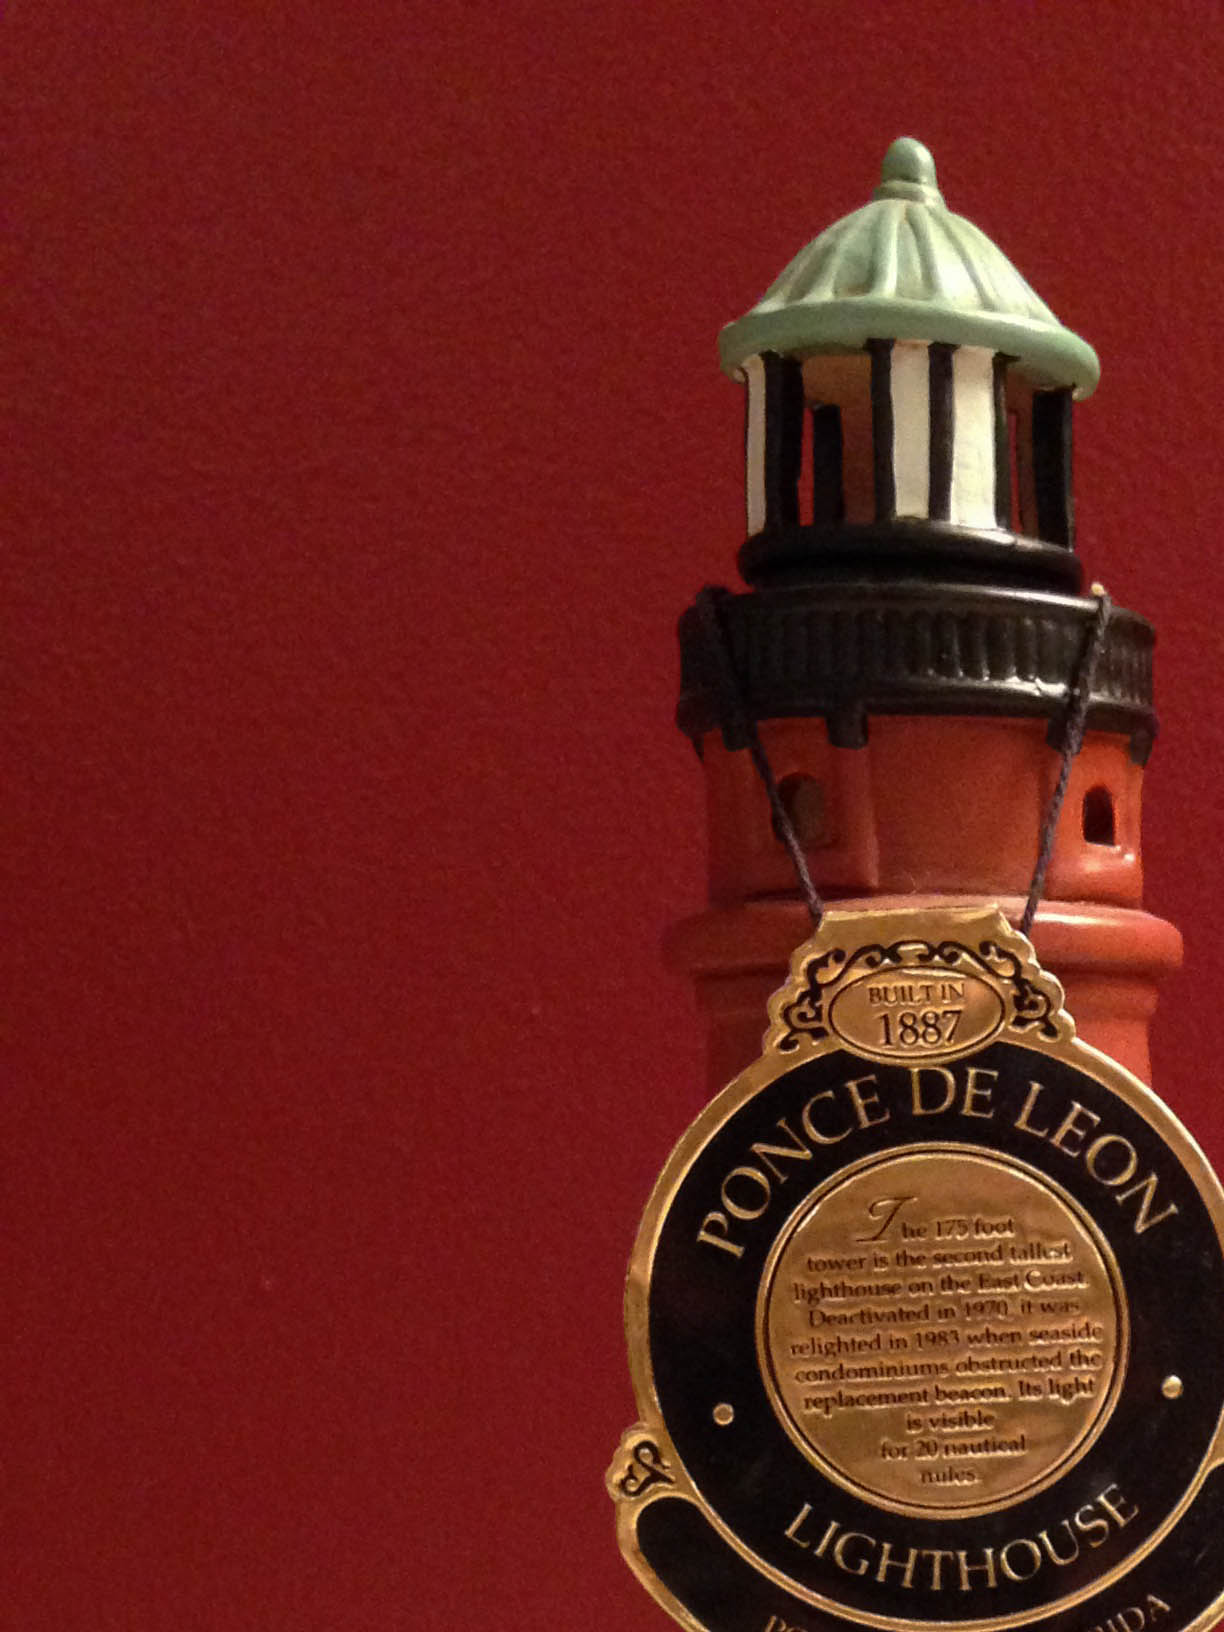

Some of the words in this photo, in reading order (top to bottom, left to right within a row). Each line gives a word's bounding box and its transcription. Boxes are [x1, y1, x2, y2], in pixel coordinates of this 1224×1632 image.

[868, 984, 932, 1005] BUILT
[940, 982, 966, 1001] IN
[877, 1009, 963, 1047] 1887
[696, 1074, 891, 1259] PONCE
[909, 1066, 999, 1120] DE
[1013, 1080, 1179, 1235] LEON
[936, 1218, 970, 1239] 175
[973, 1217, 1016, 1237] foot
[806, 1256, 867, 1273] tower
[873, 1252, 889, 1269] is
[896, 1249, 926, 1267] the
[933, 1245, 1004, 1264] second
[793, 1281, 902, 1306] lighthouse
[908, 1280, 934, 1296] on
[940, 1274, 971, 1292] the
[978, 1271, 1019, 1292] East
[808, 1303, 930, 1328] Deactivated
[937, 1306, 956, 1320] in
[1020, 1299, 1032, 1314] it
[1040, 1300, 1081, 1314] was
[790, 1332, 882, 1357] relighted
[889, 1335, 908, 1350] in
[916, 1329, 960, 1349] 1983
[967, 1326, 1022, 1345] when
[1029, 1321, 1104, 1342] seaside
[794, 1362, 950, 1383] condominiums
[955, 1350, 1063, 1373] obstructed
[1069, 1348, 1103, 1368] the
[803, 1389, 929, 1416] replacement
[1018, 1379, 1043, 1398] Its
[1048, 1376, 1097, 1402] light
[906, 1414, 923, 1431] is
[928, 1409, 996, 1431] visible
[880, 1440, 908, 1459] for
[914, 1439, 940, 1459] 20
[944, 1434, 1027, 1458] nautical
[783, 1482, 1140, 1592] LIGHTHOUSE
